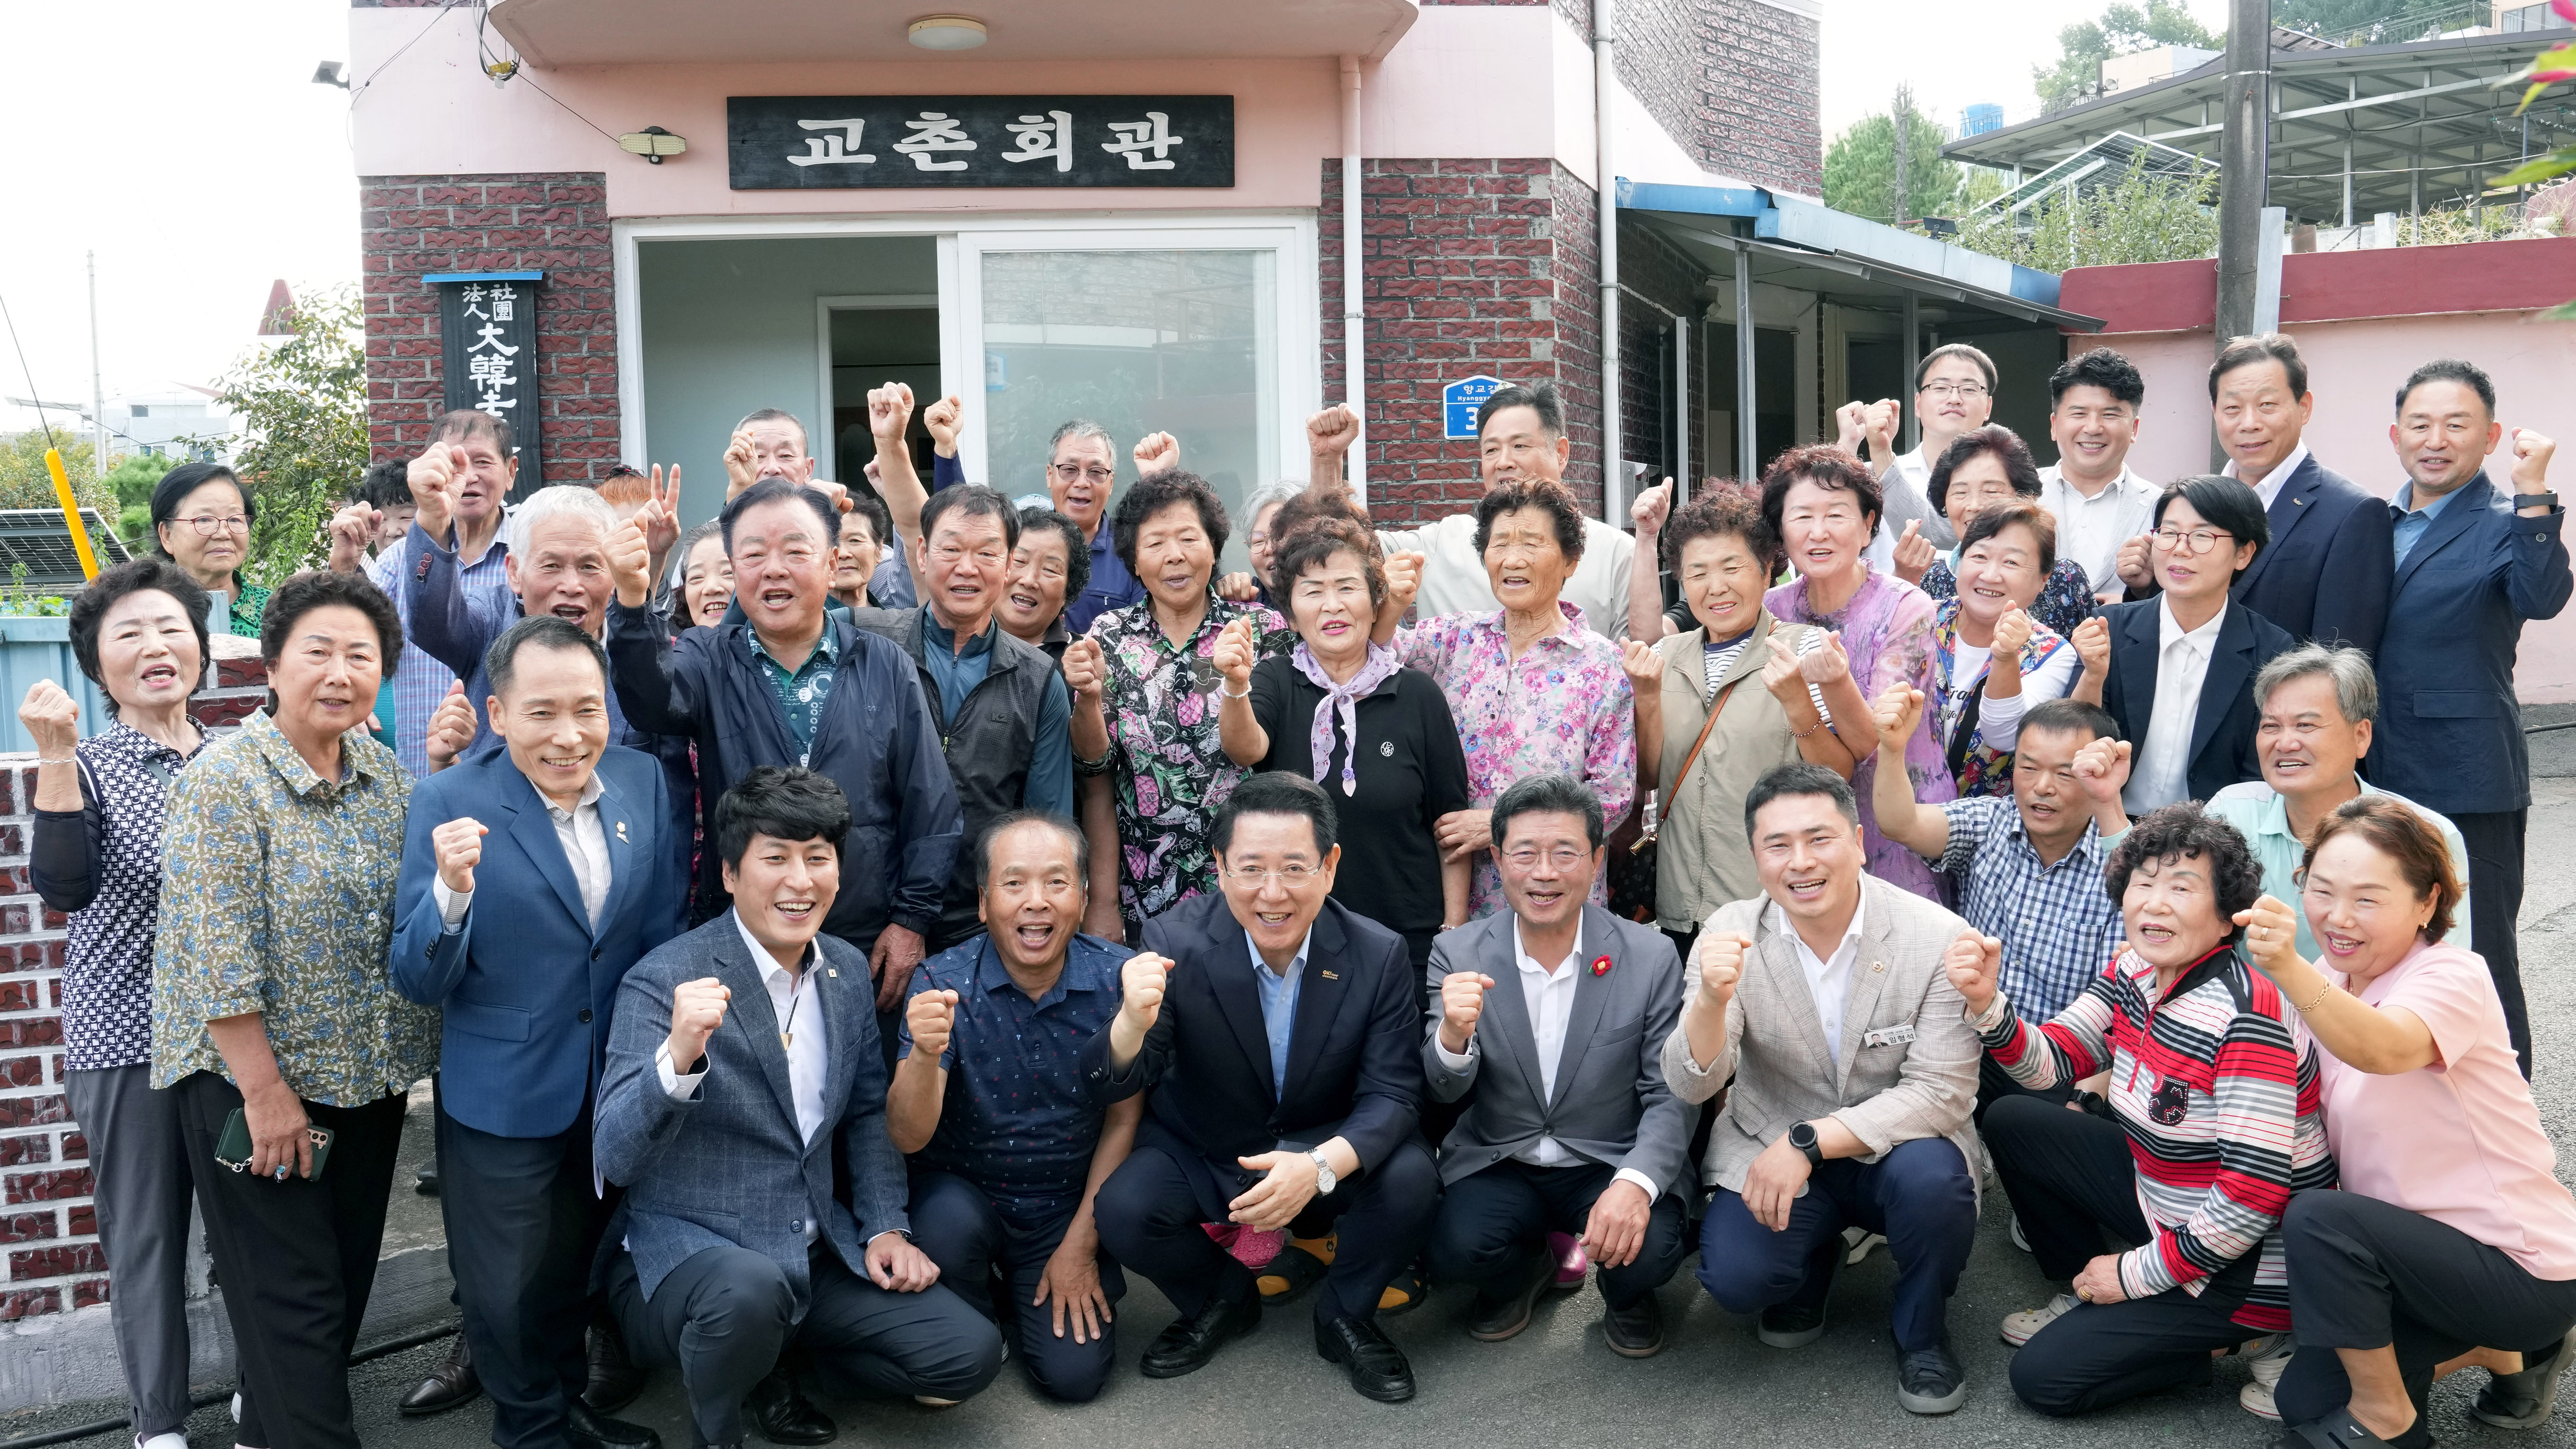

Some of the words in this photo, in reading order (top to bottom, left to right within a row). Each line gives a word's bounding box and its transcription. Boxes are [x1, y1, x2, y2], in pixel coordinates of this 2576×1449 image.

[786, 109, 1183, 172] 교촌회관
[1463, 384, 1497, 394] 향교길
[1889, 1033, 1914, 1043] 임형석
